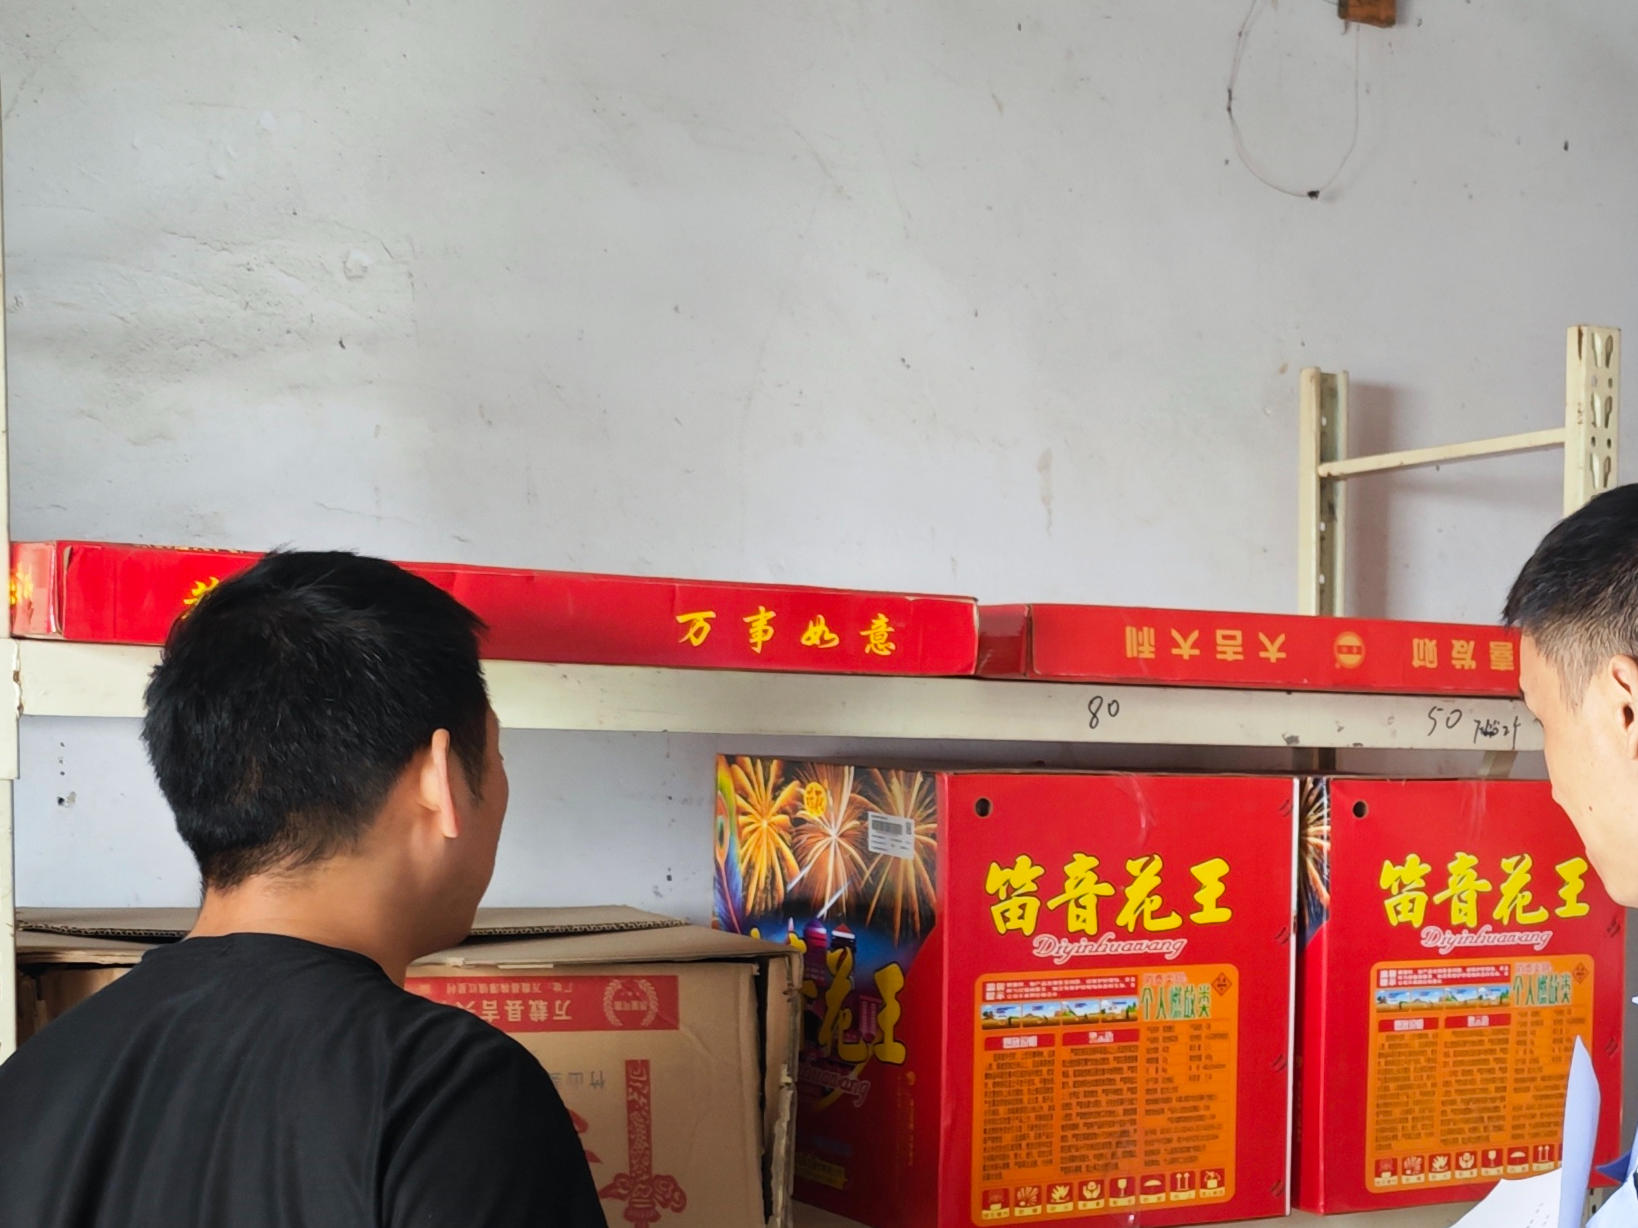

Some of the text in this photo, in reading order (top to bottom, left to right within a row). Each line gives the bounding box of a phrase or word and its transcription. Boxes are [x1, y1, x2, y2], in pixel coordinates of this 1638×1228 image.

[676, 607, 898, 658] 万事如意
[1124, 625, 1515, 671] 大吉大利 喜发财
[1087, 695, 1119, 730] 80
[1427, 705, 1463, 737] 50
[984, 852, 1235, 936] 笛音花王
[1379, 852, 1590, 928] 笛音花王
[1032, 931, 1188, 965] Diyinhuawang
[1420, 924, 1553, 955] Diyinhuawang
[440, 999, 573, 1023] 万载县吉
[1141, 984, 1212, 1021] 个人燃放类
